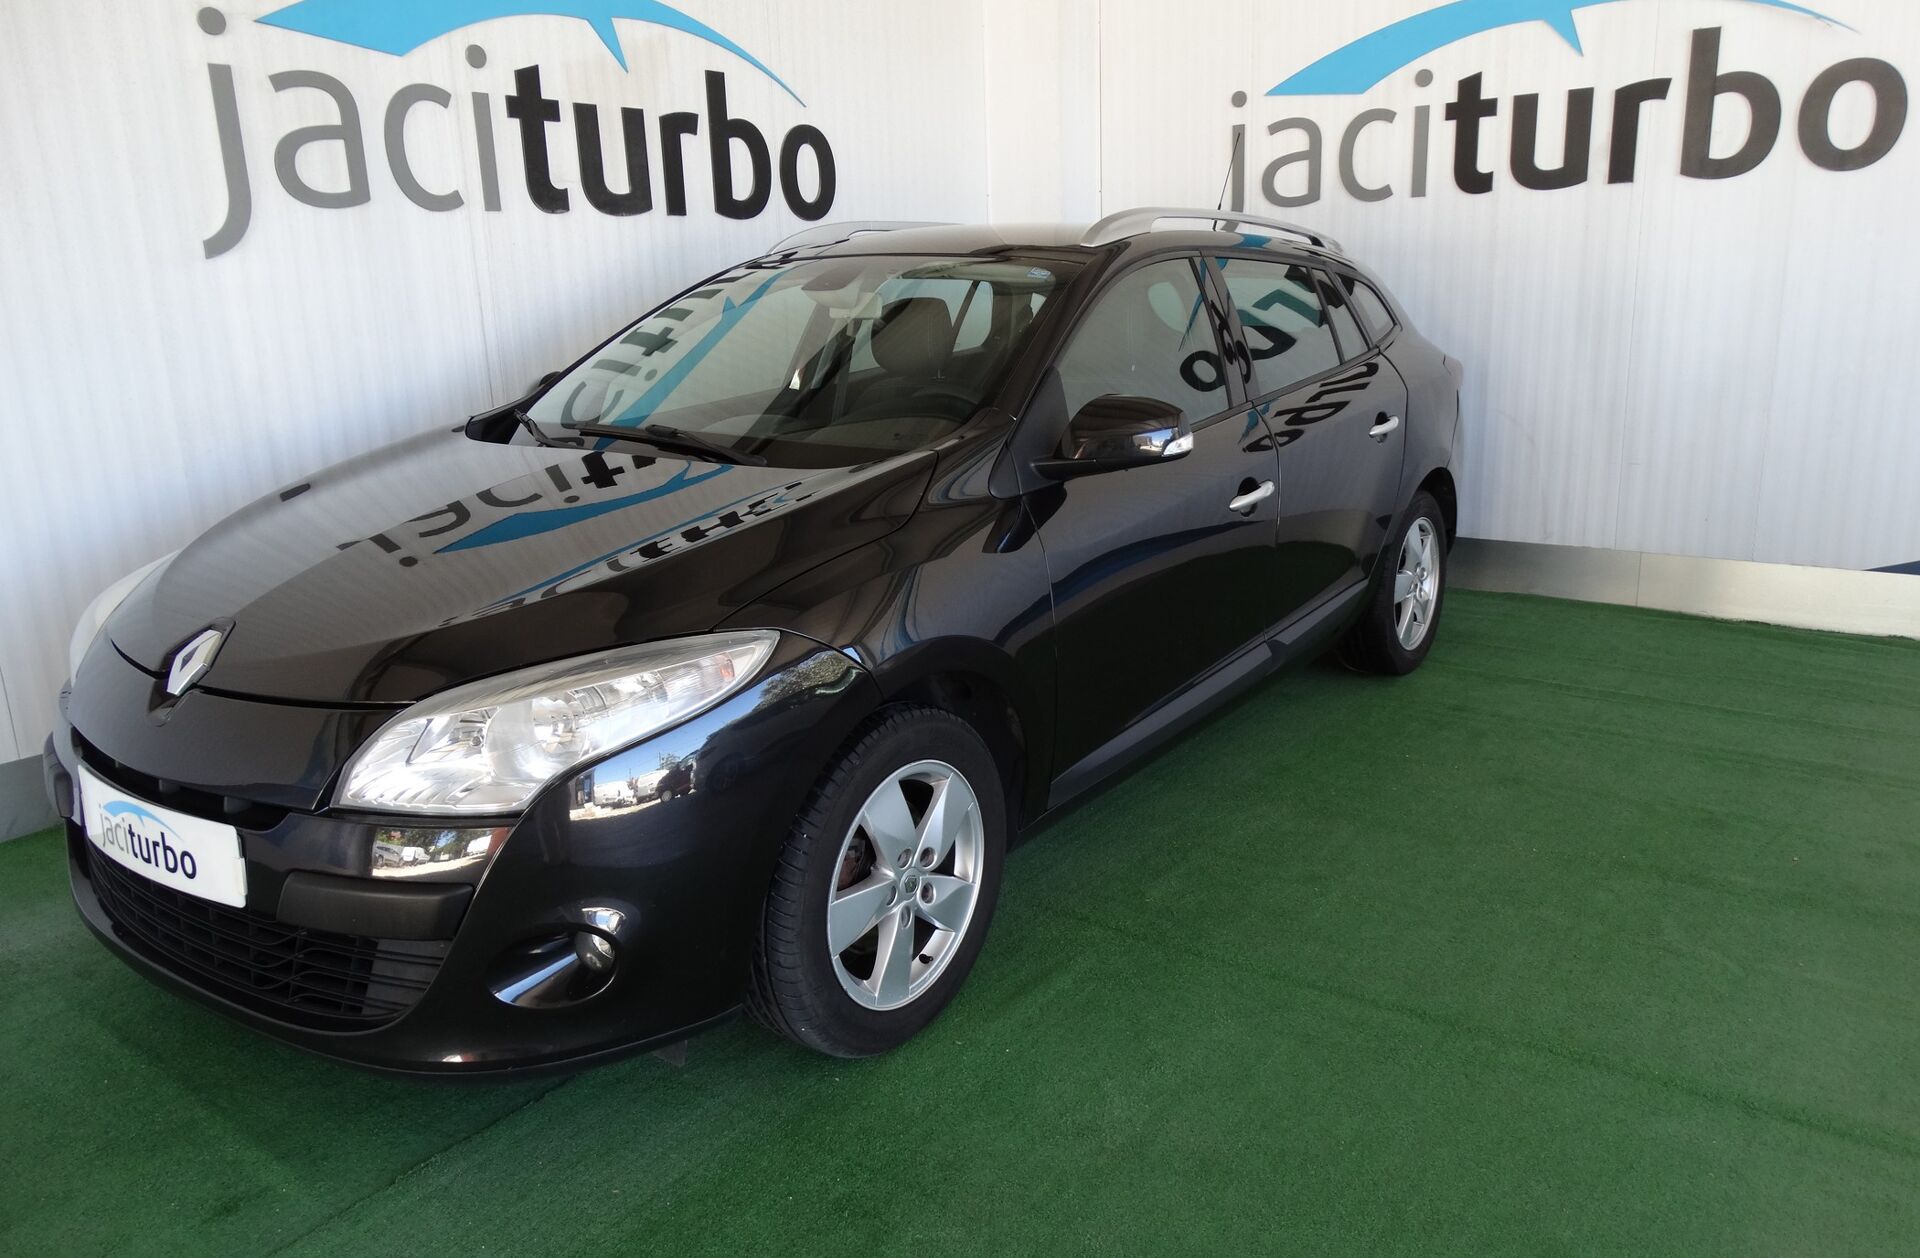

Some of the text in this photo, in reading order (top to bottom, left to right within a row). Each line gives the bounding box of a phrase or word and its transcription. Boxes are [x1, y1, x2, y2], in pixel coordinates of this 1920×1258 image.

[197, 7, 837, 259] jaciturbo
[1220, 26, 1908, 232] jaciturbo
[98, 803, 197, 879] jaciturbo
